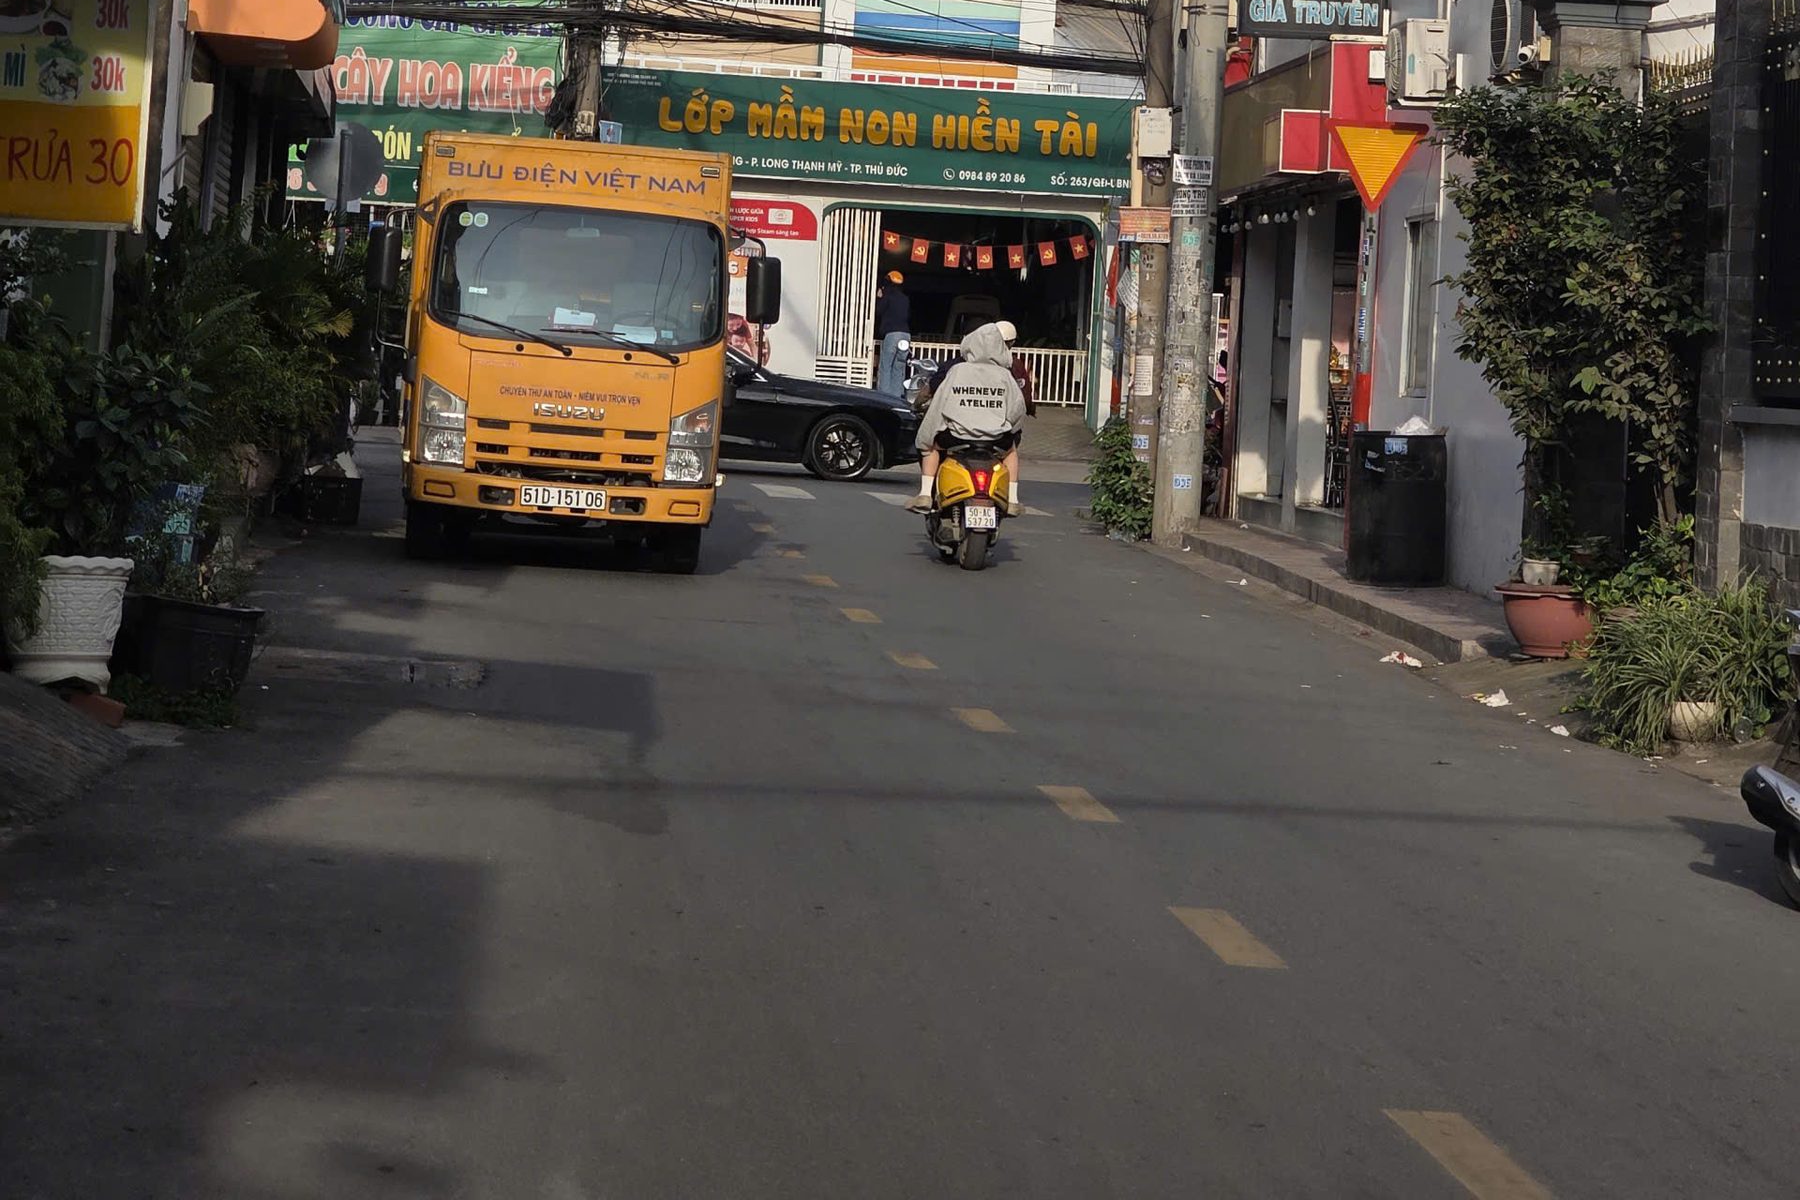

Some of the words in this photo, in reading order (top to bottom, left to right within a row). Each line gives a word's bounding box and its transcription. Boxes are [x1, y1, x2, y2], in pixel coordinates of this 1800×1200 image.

[3, 43, 26, 88] MÌ
[91, 56, 125, 92] 30k
[330, 46, 393, 106] CÂY
[397, 58, 464, 111] HOA
[468, 46, 556, 115] KIỂNG
[658, 87, 735, 135] LỚP
[747, 84, 825, 142] MẦM
[839, 107, 917, 147] NON
[932, 97, 1020, 153] HIỀN
[1034, 111, 1097, 157] TÀI
[85, 138, 134, 187] 30
[751, 157, 759, 167] P.
[762, 158, 790, 169] LONG
[792, 159, 825, 173] THẠNH
[828, 158, 842, 172] MỸ
[850, 162, 863, 173] TP.
[864, 160, 884, 175] THỦ
[886, 162, 908, 177] ĐỨC
[448, 159, 503, 180] BƯU
[513, 163, 577, 188] ĐIỆN
[584, 168, 641, 193] VIỆT
[648, 176, 706, 195] NAM
[959, 170, 983, 181] 0984
[985, 171, 997, 182] 89
[999, 172, 1011, 183] 20
[1013, 173, 1026, 184] 86
[1050, 171, 1068, 186] SỐ:
[1070, 176, 1131, 189] 263/QĐ-UBN
[734, 247, 761, 257] SINH
[528, 387, 542, 397] THƯ
[543, 388, 554, 398] AN
[554, 388, 573, 400] TOÀN
[578, 390, 596, 401] NIỀM
[596, 393, 607, 402] VUI
[608, 394, 626, 405] TRỌN
[628, 395, 641, 407] VẸN
[959, 398, 1003, 409] ATELIER
[533, 401, 606, 421] ISUZU
[969, 507, 992, 518] 50-AC
